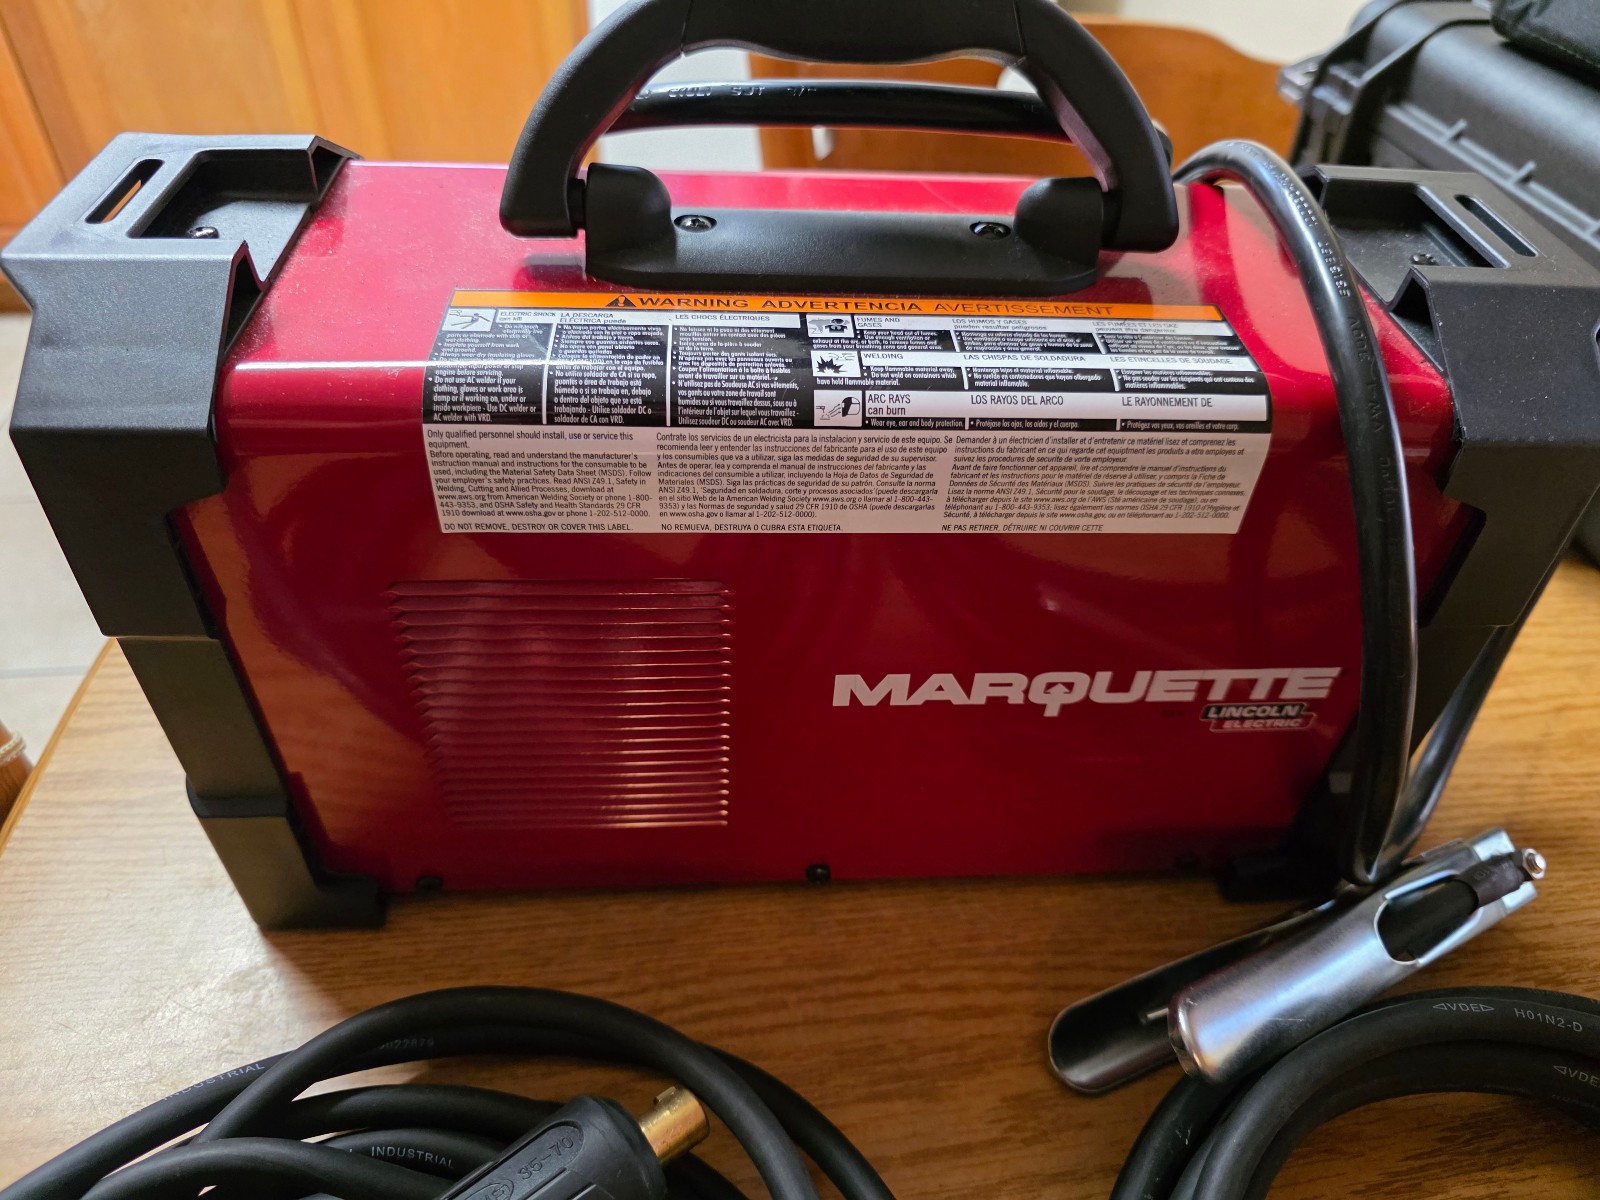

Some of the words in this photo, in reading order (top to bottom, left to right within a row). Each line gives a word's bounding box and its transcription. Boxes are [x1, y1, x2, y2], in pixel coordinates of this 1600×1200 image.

[638, 298, 748, 308] WARNING
[762, 300, 922, 311] ADVERTENCIA
[934, 303, 1112, 315] AVERTISSEMENT
[868, 395, 886, 403] ARC
[888, 395, 910, 404] RAYS
[971, 395, 988, 404] LOS
[990, 396, 1019, 405] RAYOS
[1021, 396, 1037, 405] DEL
[1040, 396, 1063, 405] ARCO
[1122, 397, 1133, 406] LE
[1135, 397, 1198, 407] RAYONNEMENT
[1201, 398, 1212, 407] DE
[889, 406, 905, 415] burn
[433, 414, 441, 422] AC
[442, 414, 462, 422] welder
[463, 414, 476, 422] with
[477, 414, 492, 422] VRD.
[427, 430, 443, 441] Only
[444, 430, 477, 441] qualified
[478, 430, 514, 441] personnel
[515, 431, 540, 439] should
[542, 431, 566, 442] install,
[592, 431, 618, 440] service
[619, 431, 633, 440] this
[656, 432, 686, 441] Contrate
[688, 433, 698, 441] los
[699, 433, 731, 442] servicios
[732, 433, 741, 442] de
[753, 433, 791, 442] electricista
[793, 436, 809, 444] para
[810, 434, 817, 442] la
[818, 434, 856, 443] instalacion
[857, 436, 862, 445] y
[863, 434, 890, 443] servicio
[891, 434, 900, 443] de
[901, 435, 916, 443] este
[917, 435, 942, 445] equipo.
[943, 435, 952, 443] Se
[428, 441, 469, 450] equipment.
[455, 451, 491, 460] operating,
[433, 468, 453, 477] used,
[454, 468, 488, 477] including
[488, 468, 500, 476] the
[533, 469, 556, 478] Safety
[597, 469, 627, 478] (MSDS).
[451, 477, 491, 486] employer's
[493, 477, 516, 486] safety
[516, 477, 550, 486] practices.
[591, 478, 614, 486] Z49.1,
[615, 478, 637, 486] Safety
[436, 485, 466, 494] Welding,
[467, 486, 494, 494] Cutting
[531, 486, 569, 494] Processes,
[505, 509, 556, 518] www.osha.gov
[565, 509, 587, 518] phone
[473, 523, 510, 532] REMOVE,
[674, 524, 713, 532] REMUEVA,
[968, 524, 1000, 533] RETIRER,
[832, 667, 1342, 717] MARQUETTE
[1207, 705, 1300, 718] LINCOLN
[1222, 719, 1302, 728] ELECTRIC
[1514, 1008, 1582, 1032] H01N2-D
[372, 1146, 454, 1168] INDUSTRIAL
